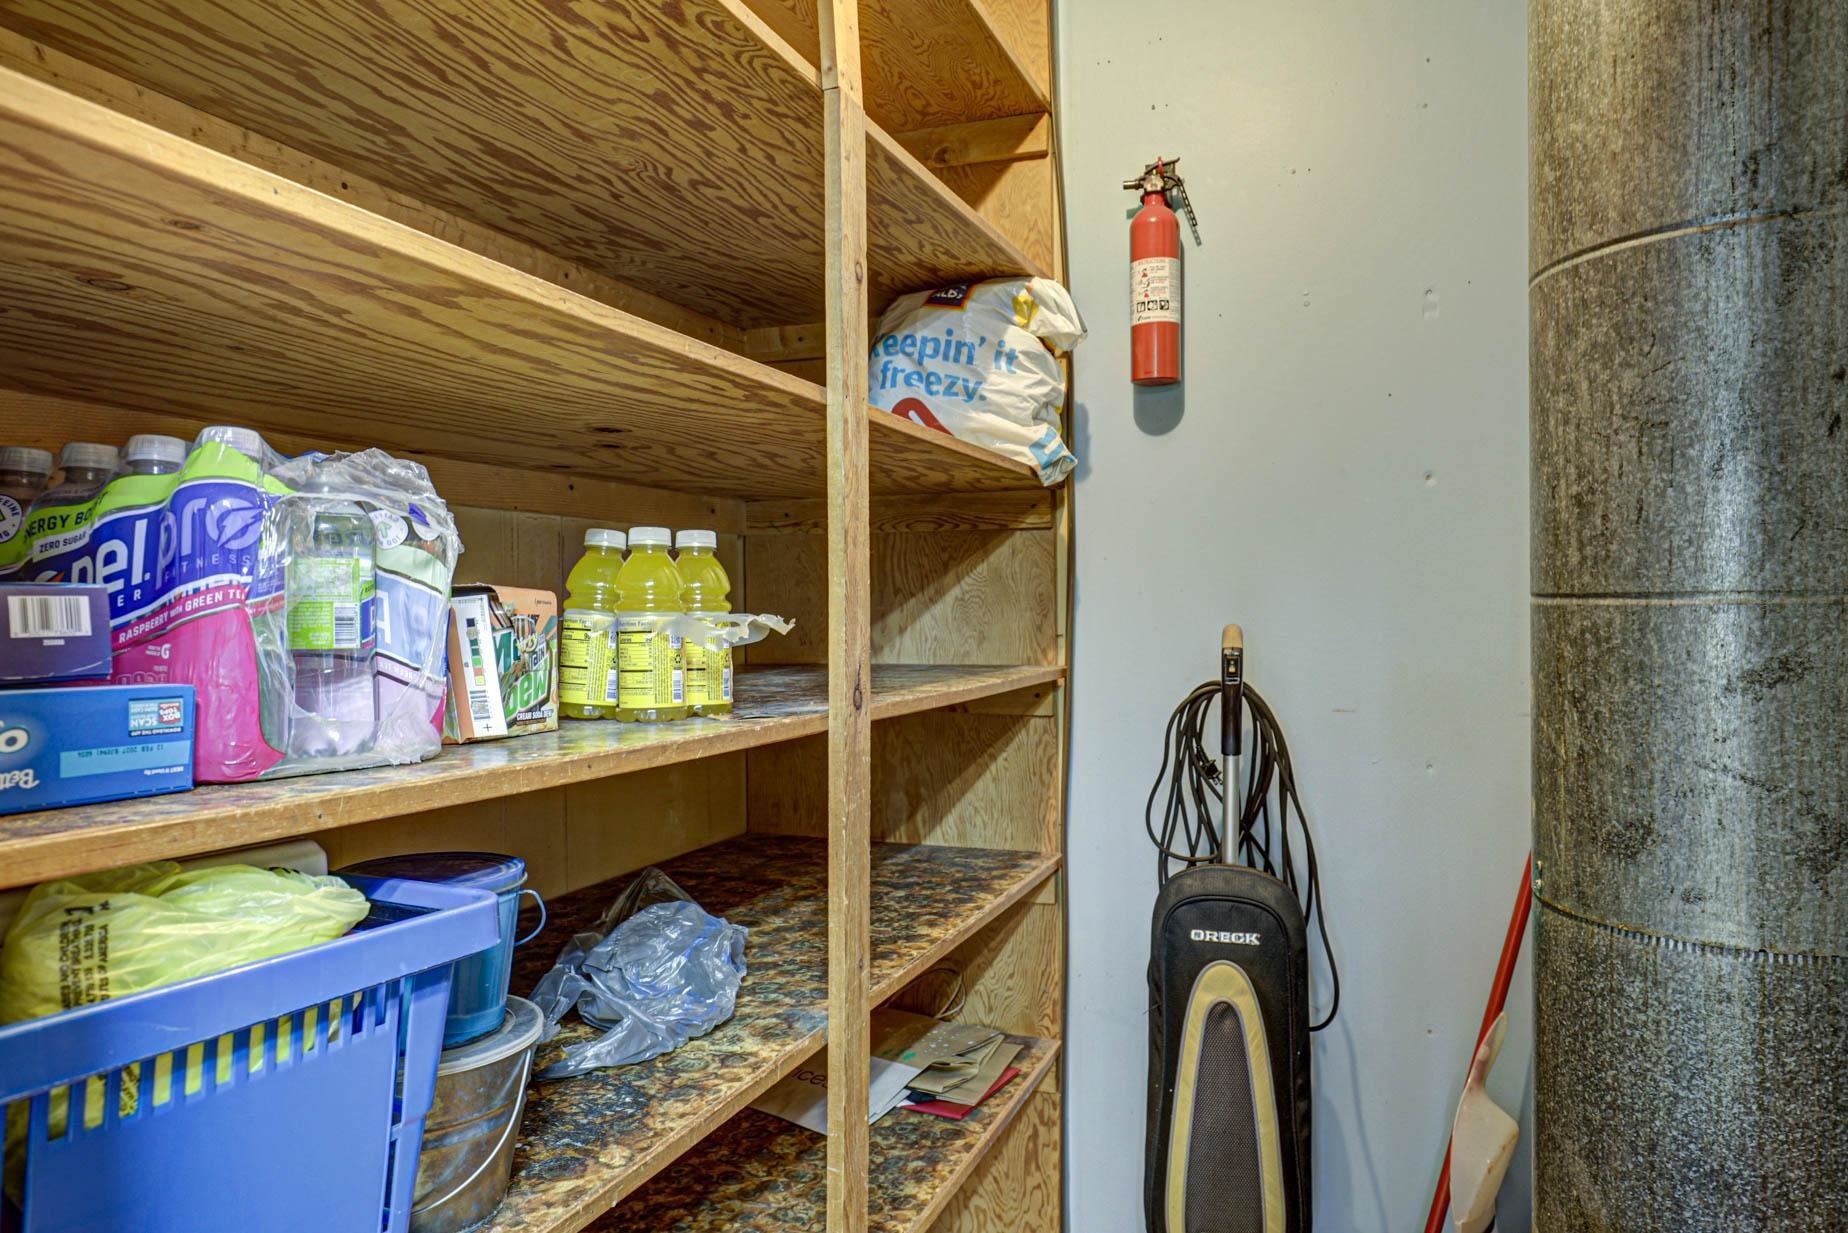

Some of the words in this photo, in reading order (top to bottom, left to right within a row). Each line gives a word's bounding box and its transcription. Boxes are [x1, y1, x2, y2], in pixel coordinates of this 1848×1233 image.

[993, 338, 1019, 375] it
[880, 359, 987, 404] freezy.
[39, 540, 61, 554] ZERO
[118, 610, 169, 644] RASPBERRY
[184, 591, 224, 611] GREEN
[130, 717, 157, 728] SCAN
[1190, 929, 1261, 946] ORECK
